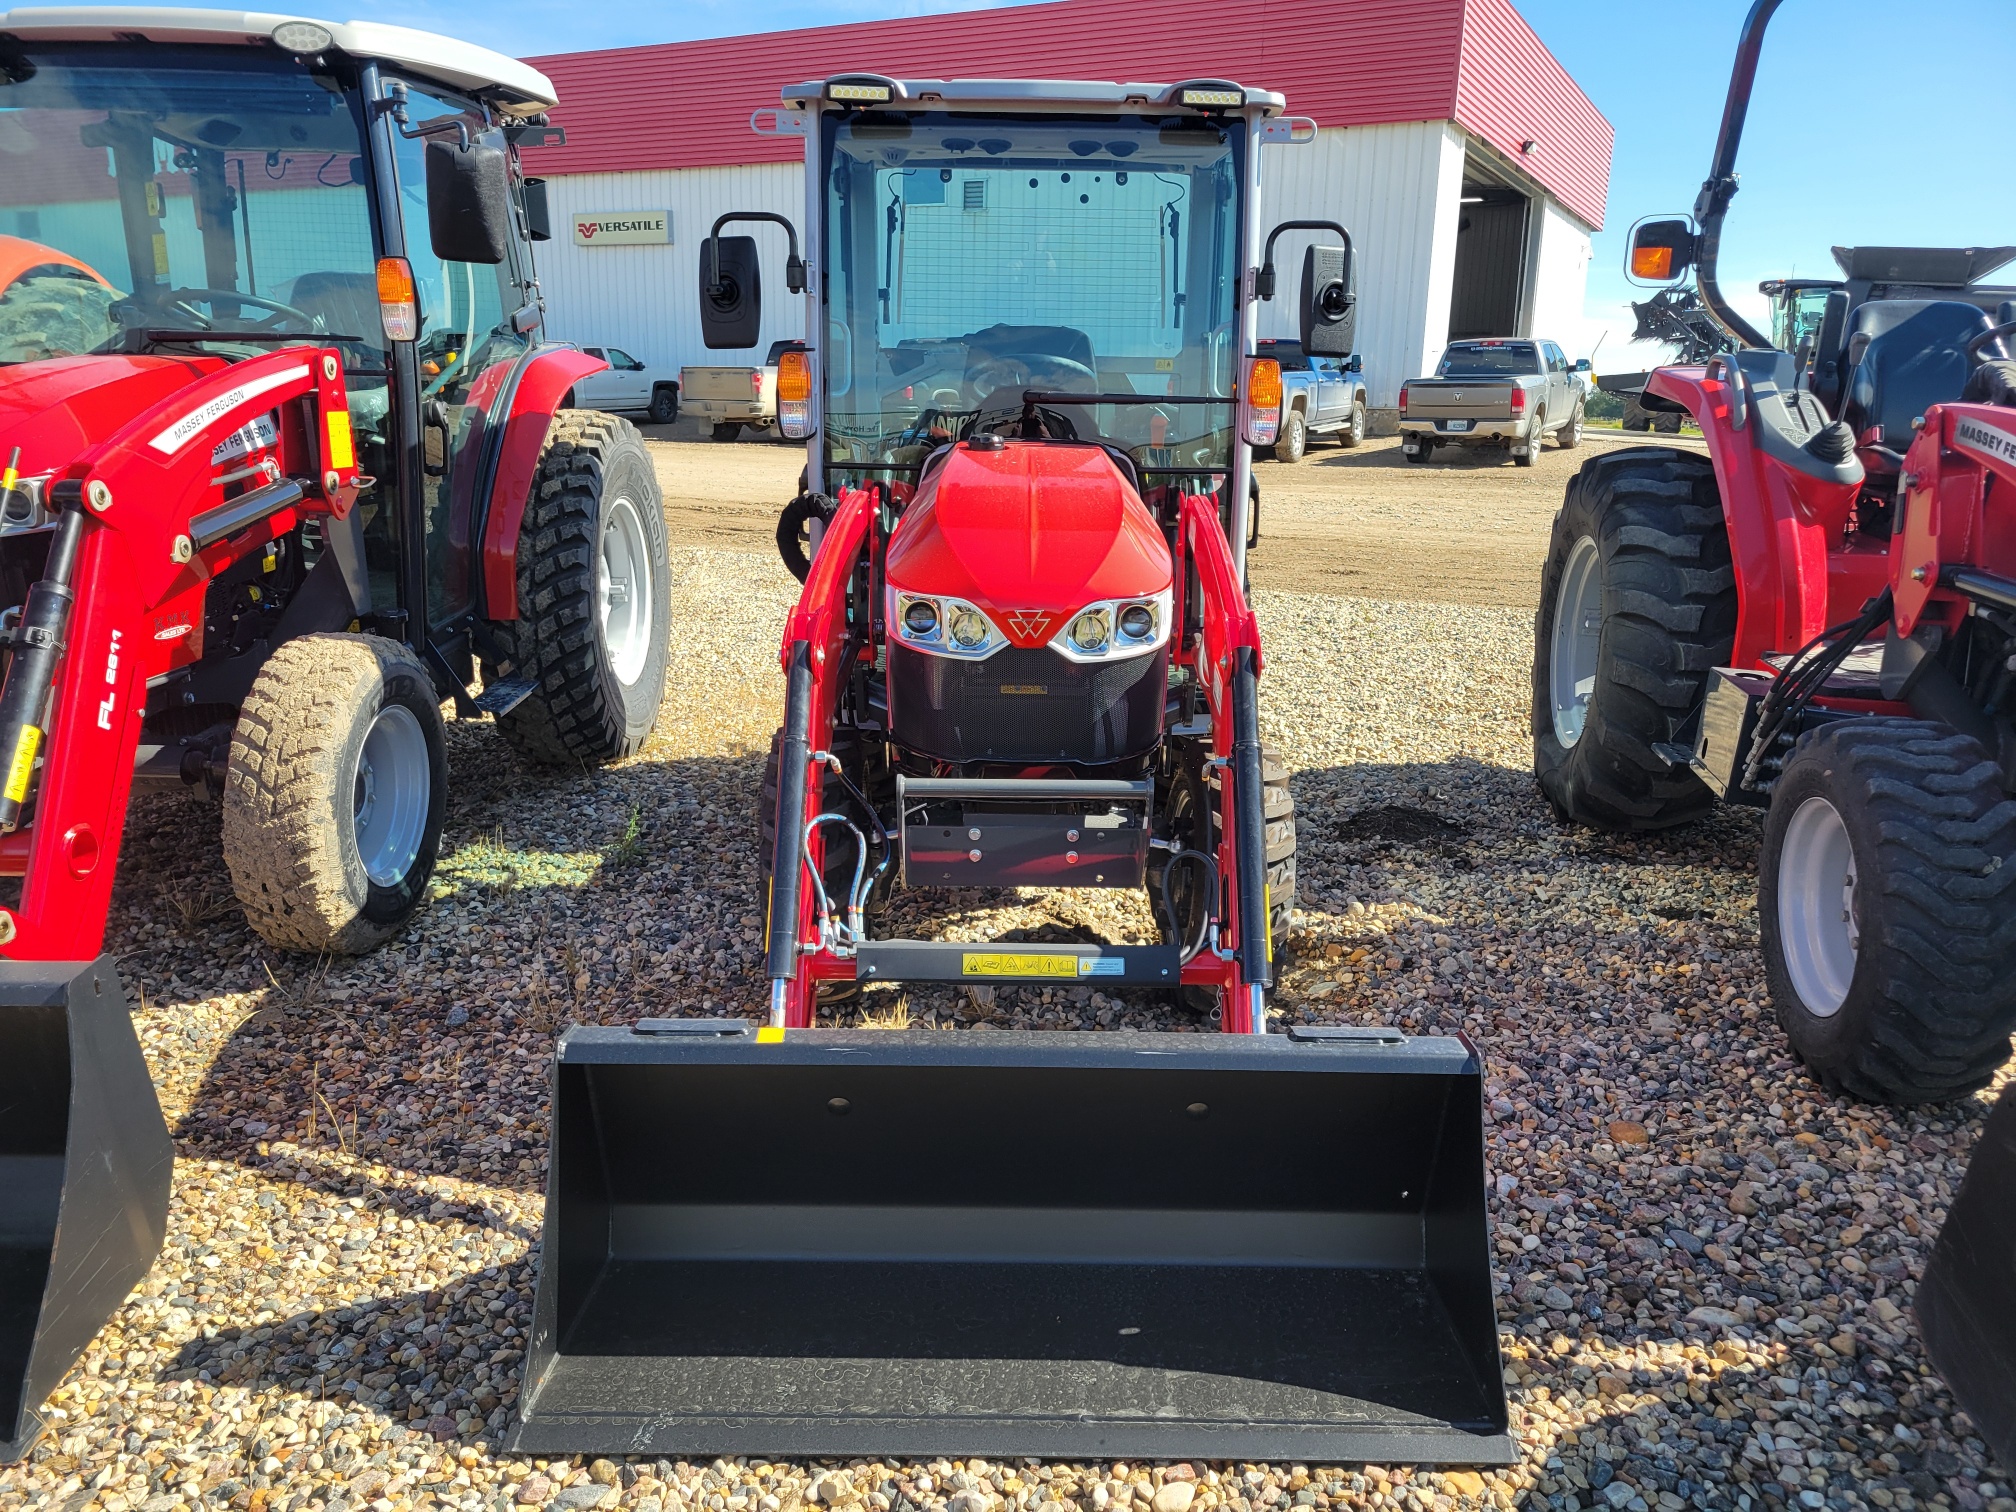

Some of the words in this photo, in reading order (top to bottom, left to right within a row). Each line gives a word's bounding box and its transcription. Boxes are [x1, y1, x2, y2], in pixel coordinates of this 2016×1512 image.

[598, 220, 664, 232] VERSATILE
[174, 412, 206, 441] MASSEY
[206, 389, 245, 419] FERGUSON
[213, 440, 229, 456] SEY
[229, 423, 272, 449] FERGUSON
[1959, 424, 2003, 452] MASSEY
[2003, 441, 2016, 460] FE
[97, 692, 116, 730] FL
